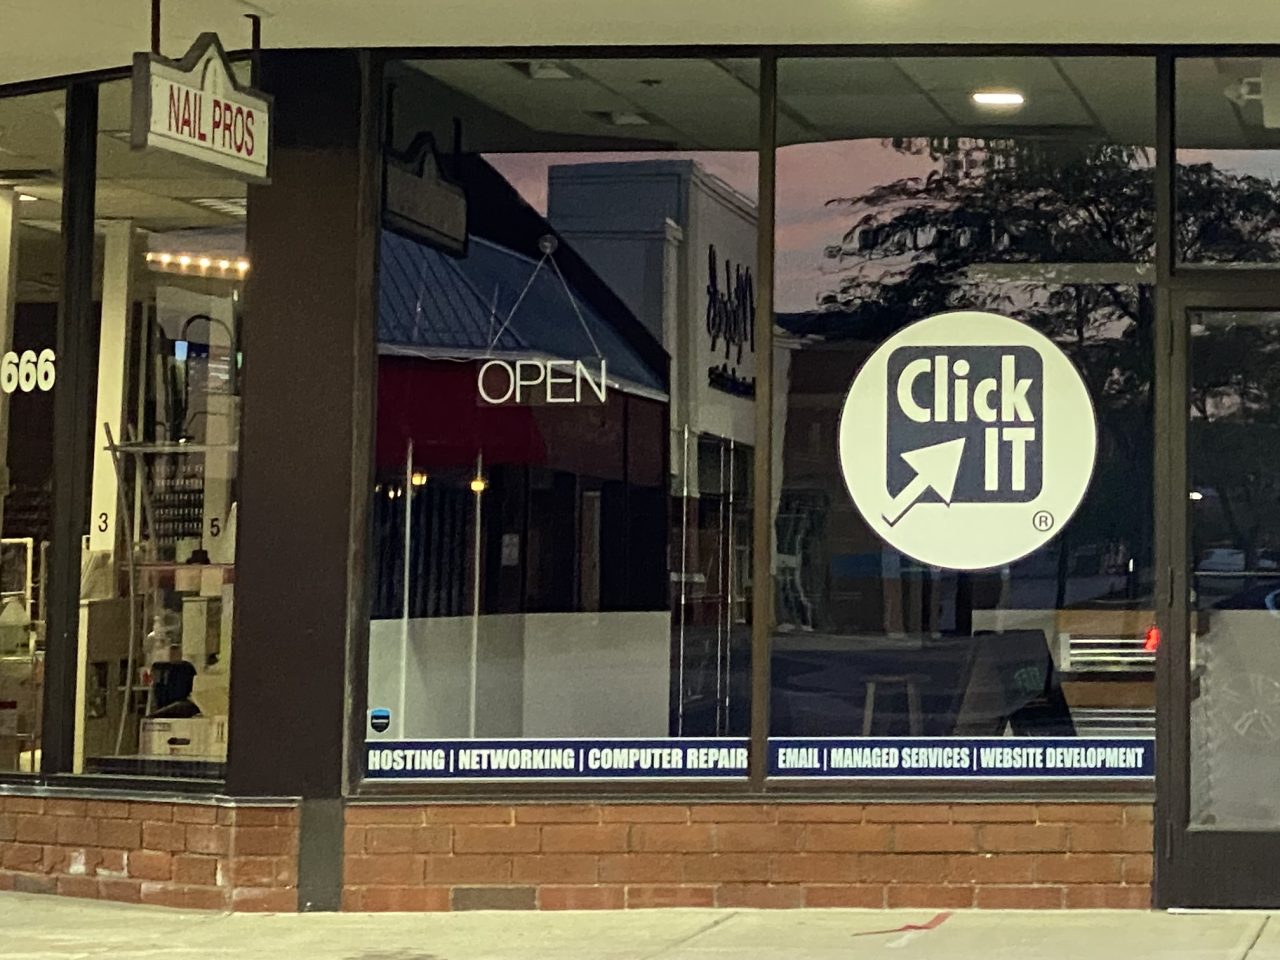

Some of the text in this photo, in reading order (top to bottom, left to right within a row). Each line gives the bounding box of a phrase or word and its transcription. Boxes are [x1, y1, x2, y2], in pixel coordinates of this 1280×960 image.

[168, 83, 256, 157] NAIL PROS
[0, 347, 56, 394] 666
[477, 358, 607, 405] OPEN
[896, 354, 1036, 424] Click
[983, 426, 1036, 492] IT
[97, 512, 109, 534] 3
[208, 517, 221, 538] 5
[367, 748, 446, 772] HOSTING
[457, 747, 576, 771] NETWORKING
[587, 747, 683, 770] COMPUTER
[686, 747, 749, 770] REPAIR
[777, 747, 821, 770] EMAIL
[830, 747, 900, 769] MANAGED
[901, 747, 970, 769] SERVICES
[980, 747, 1044, 769] WEBSITE
[1046, 747, 1145, 769] DEVELOPMENT
